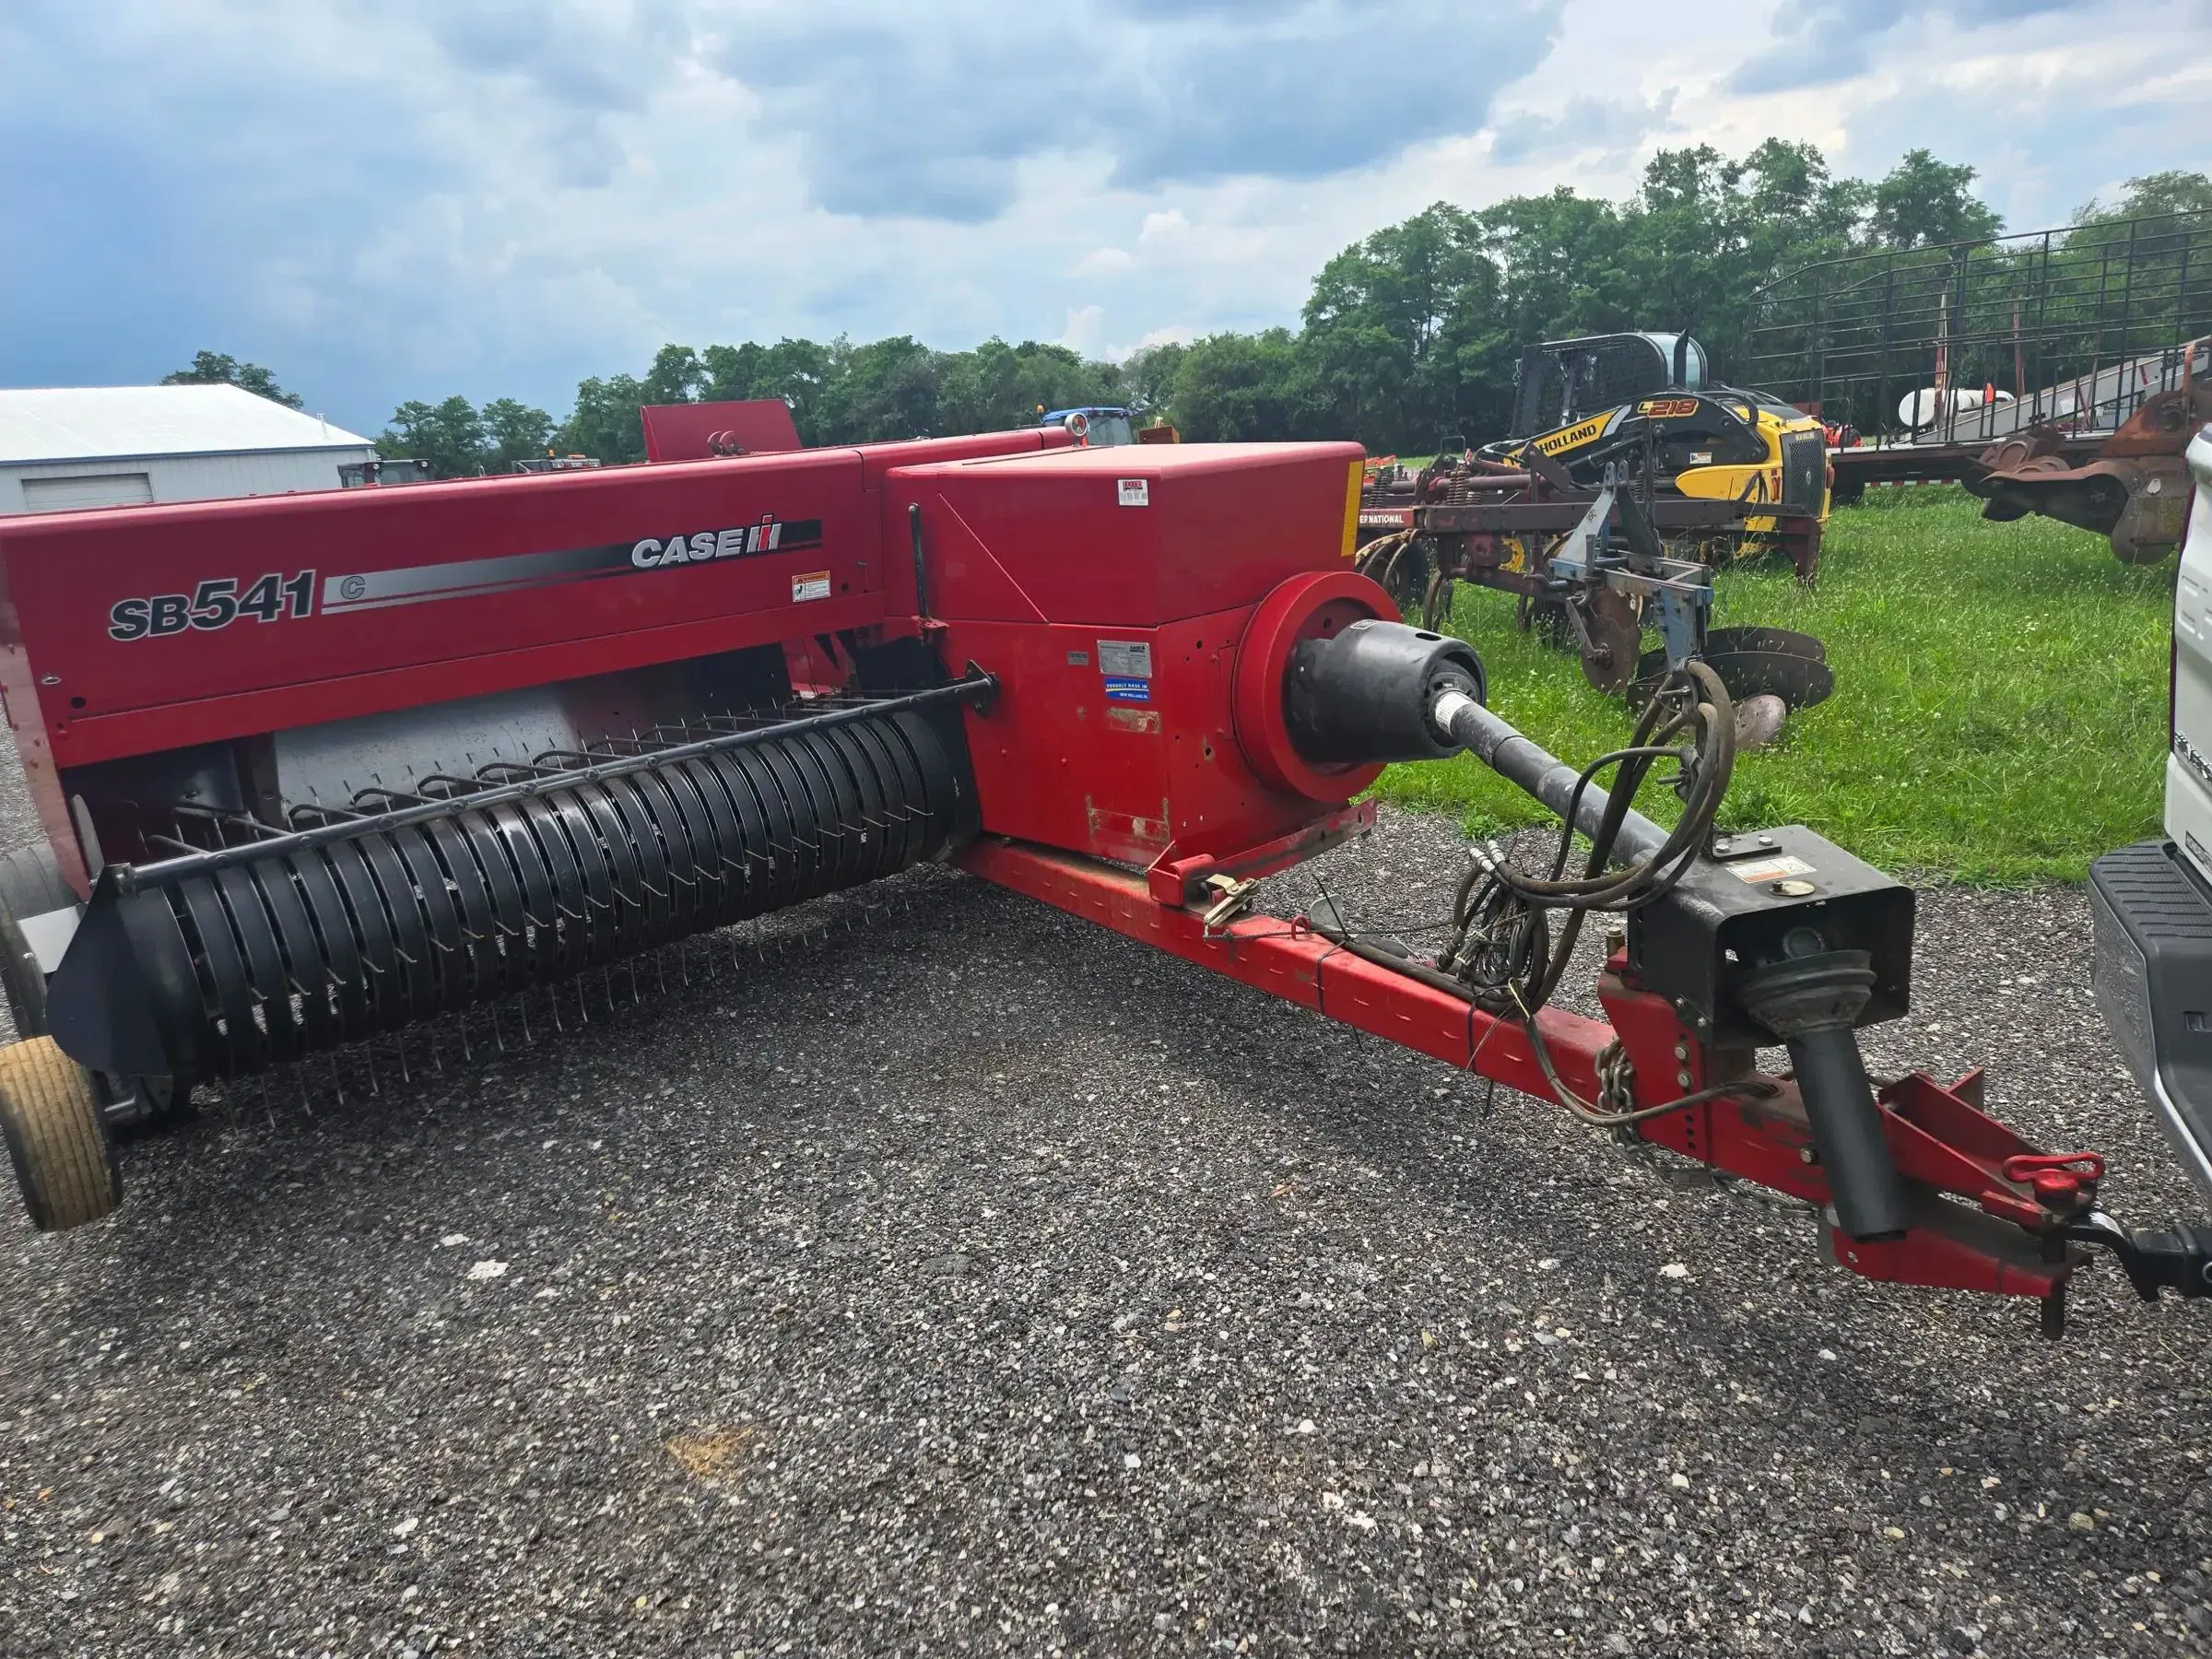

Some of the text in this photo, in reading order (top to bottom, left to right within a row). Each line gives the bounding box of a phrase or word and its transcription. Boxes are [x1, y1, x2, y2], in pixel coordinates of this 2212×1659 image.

[1639, 399, 1698, 417] L218
[1538, 424, 1597, 453] HOLLAND
[1359, 514, 1405, 524] ERNATIONAL
[631, 528, 745, 569] CASE
[108, 569, 367, 641] SB541 C
